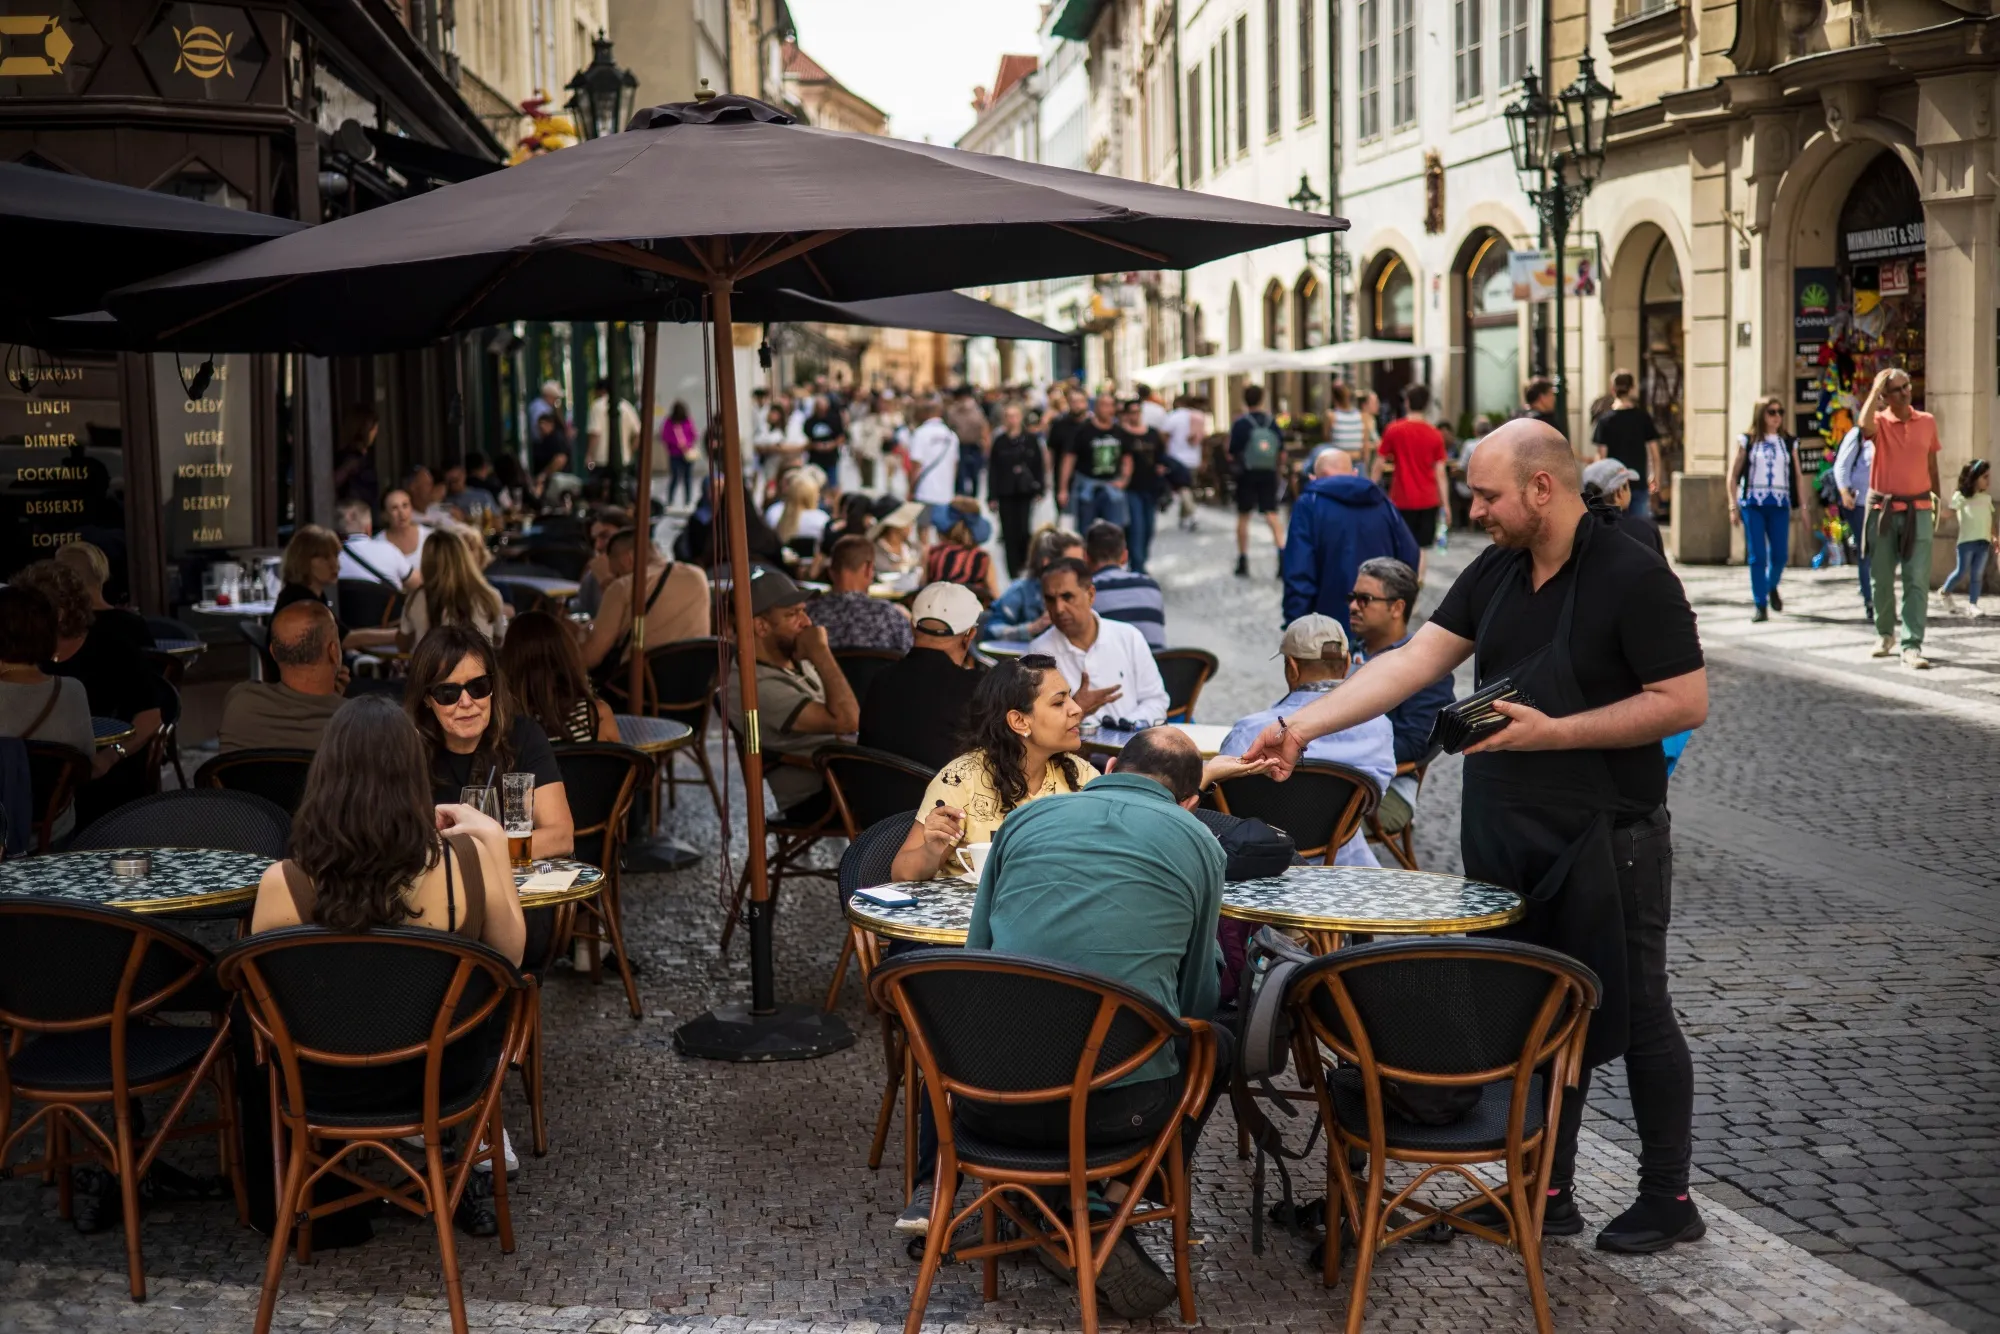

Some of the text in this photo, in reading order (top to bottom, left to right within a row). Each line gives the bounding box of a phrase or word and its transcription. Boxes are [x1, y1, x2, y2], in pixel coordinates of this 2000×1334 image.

[1846, 226, 1898, 251] MINIMARKET
[1899, 228, 1907, 244] &
[26, 401, 70, 415] LUNCH
[24, 433, 77, 448] DINNER
[17, 466, 89, 481] COCKTAILS
[26, 500, 84, 514] DESSERTS
[182, 494, 231, 511] DEZERTY
[32, 532, 82, 546] COFFEE
[753, 907, 760, 918] 3
